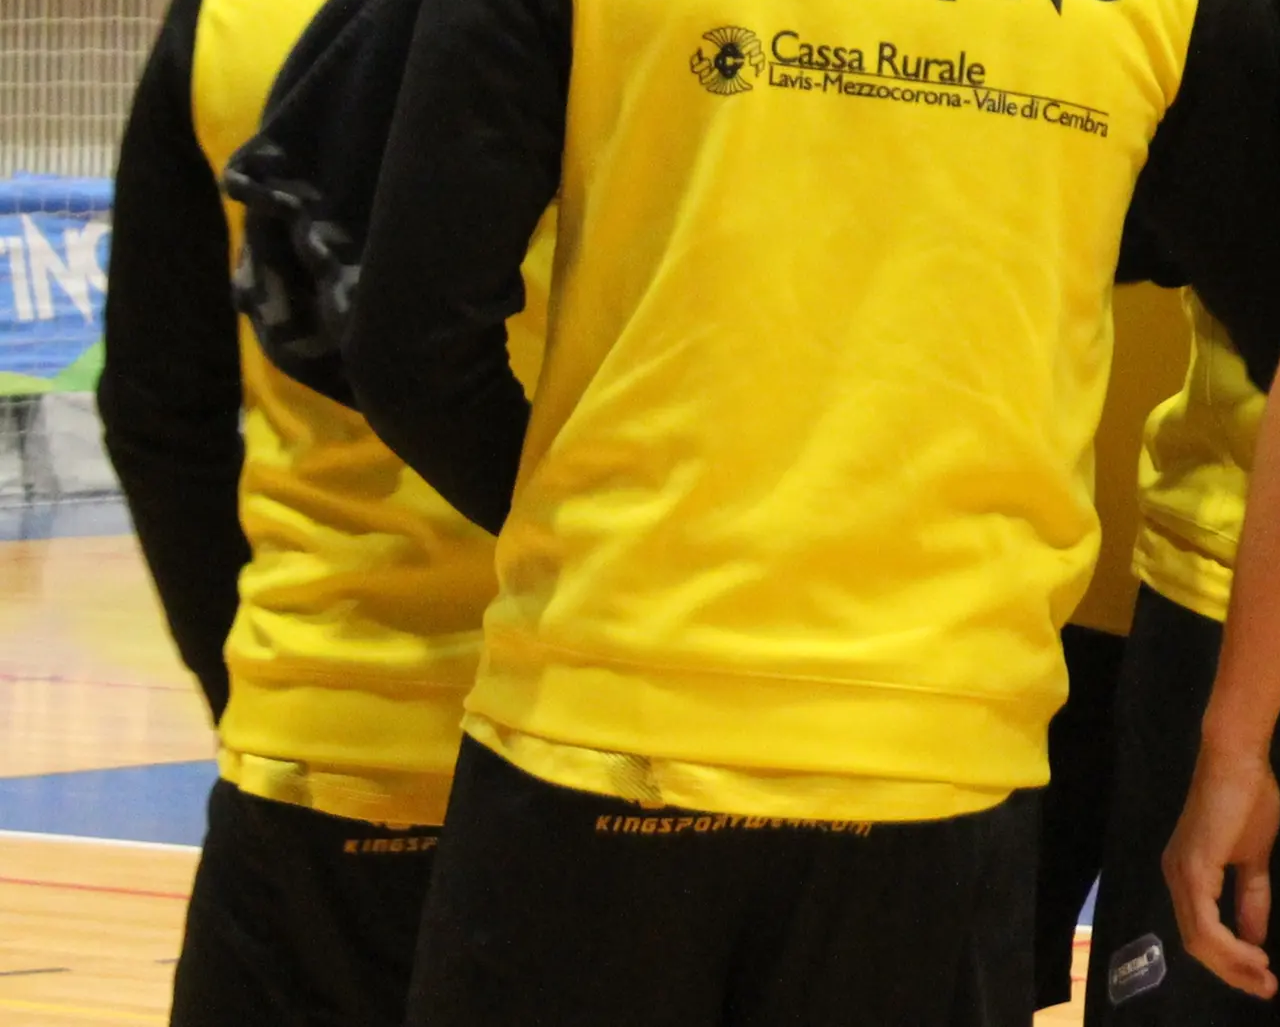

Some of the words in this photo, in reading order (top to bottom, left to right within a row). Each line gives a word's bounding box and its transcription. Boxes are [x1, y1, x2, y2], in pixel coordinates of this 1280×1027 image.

[770, 29, 865, 73] Cassa
[877, 41, 986, 87] Rurale
[1020, 96, 1039, 121] di
[1042, 102, 1109, 139] Cembra
